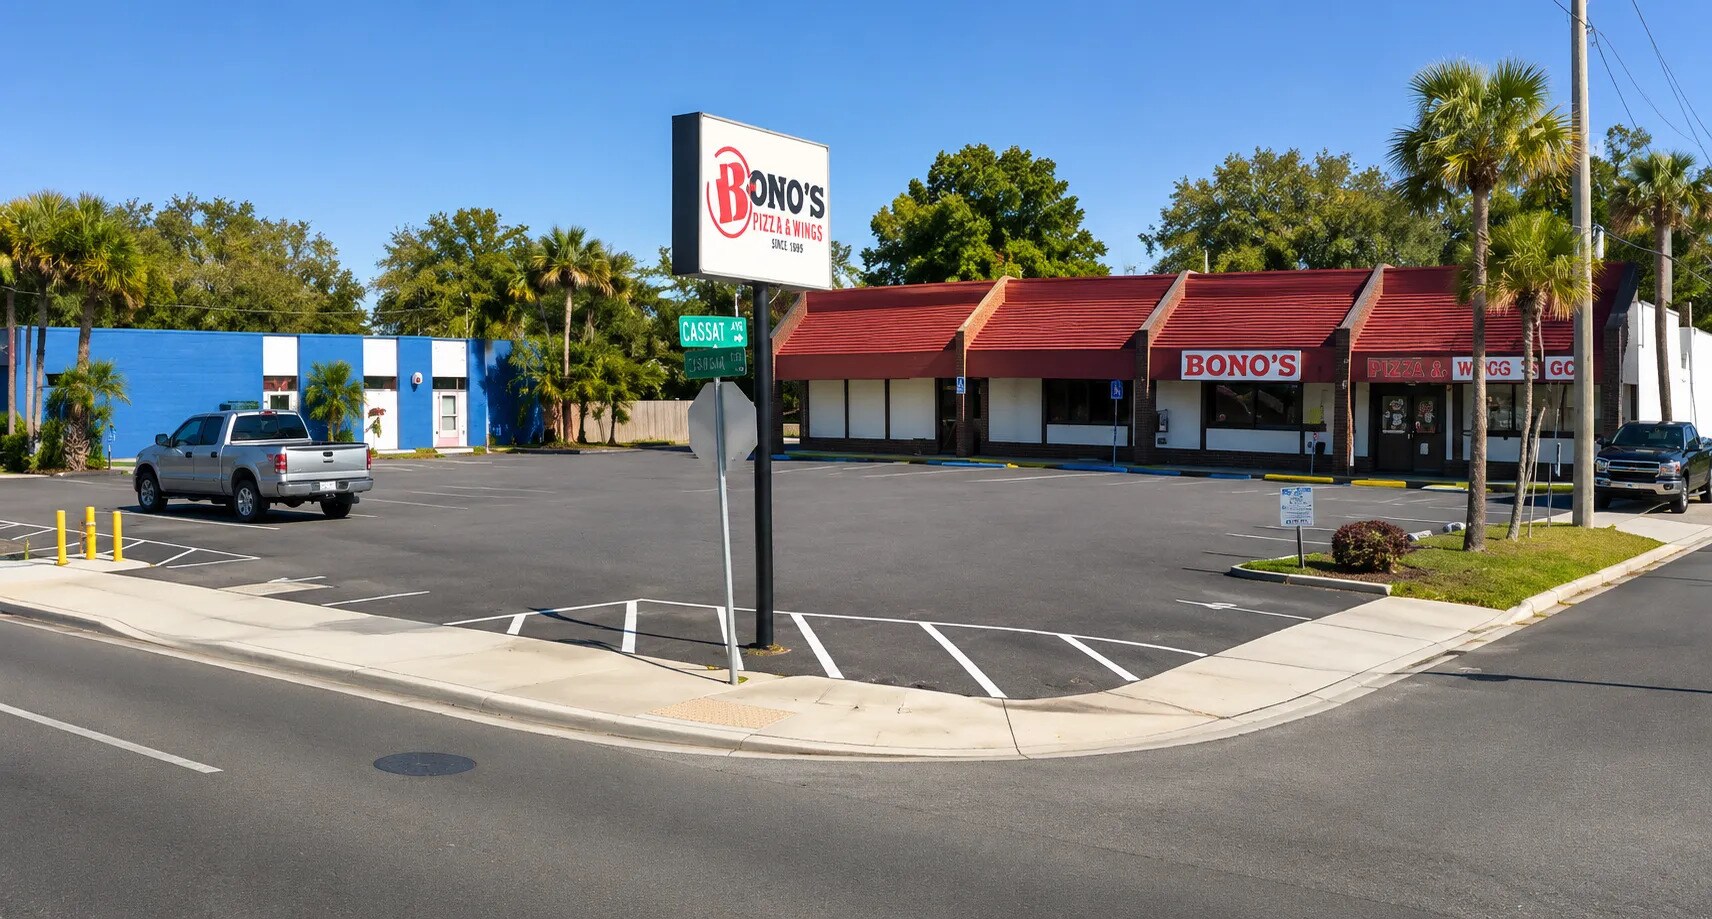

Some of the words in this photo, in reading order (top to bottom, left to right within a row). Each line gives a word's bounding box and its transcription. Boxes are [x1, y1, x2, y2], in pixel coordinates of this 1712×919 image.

[716, 162, 825, 224] BONO'S
[753, 212, 782, 235] PIZZA
[785, 218, 791, 236] &
[792, 219, 823, 242] WINGS
[771, 238, 788, 251] SINCE
[682, 321, 725, 342] CASSAT
[1184, 354, 1297, 377] BONO'S
[1367, 360, 1425, 377] PIZZA
[1430, 360, 1448, 377] &
